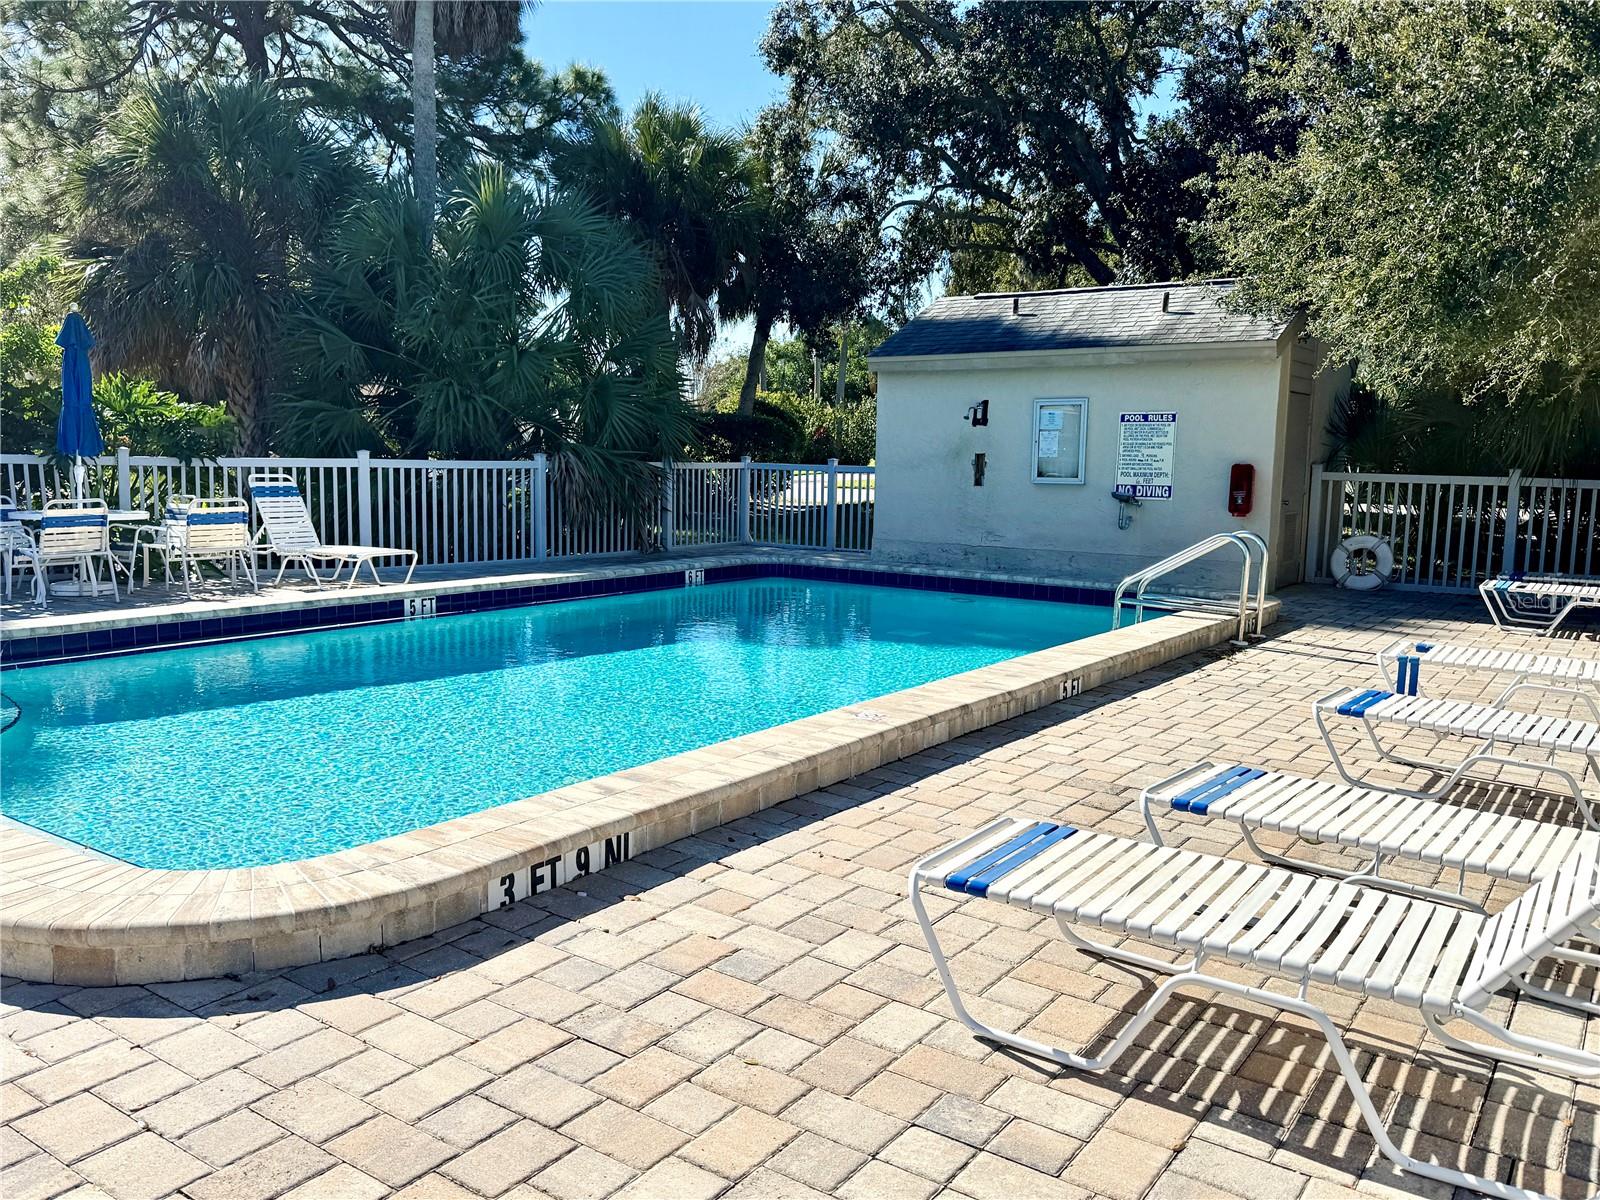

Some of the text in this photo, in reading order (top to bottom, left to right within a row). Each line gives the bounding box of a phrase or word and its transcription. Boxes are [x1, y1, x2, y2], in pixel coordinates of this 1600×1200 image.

[1124, 414, 1173, 422] POOL RULES
[1118, 485, 1169, 497] NO DIVING
[688, 569, 704, 586] 6 FT
[409, 597, 435, 618] 5 FT
[500, 873, 516, 908] 3
[530, 855, 562, 897] FT
[572, 846, 591, 882] 9
